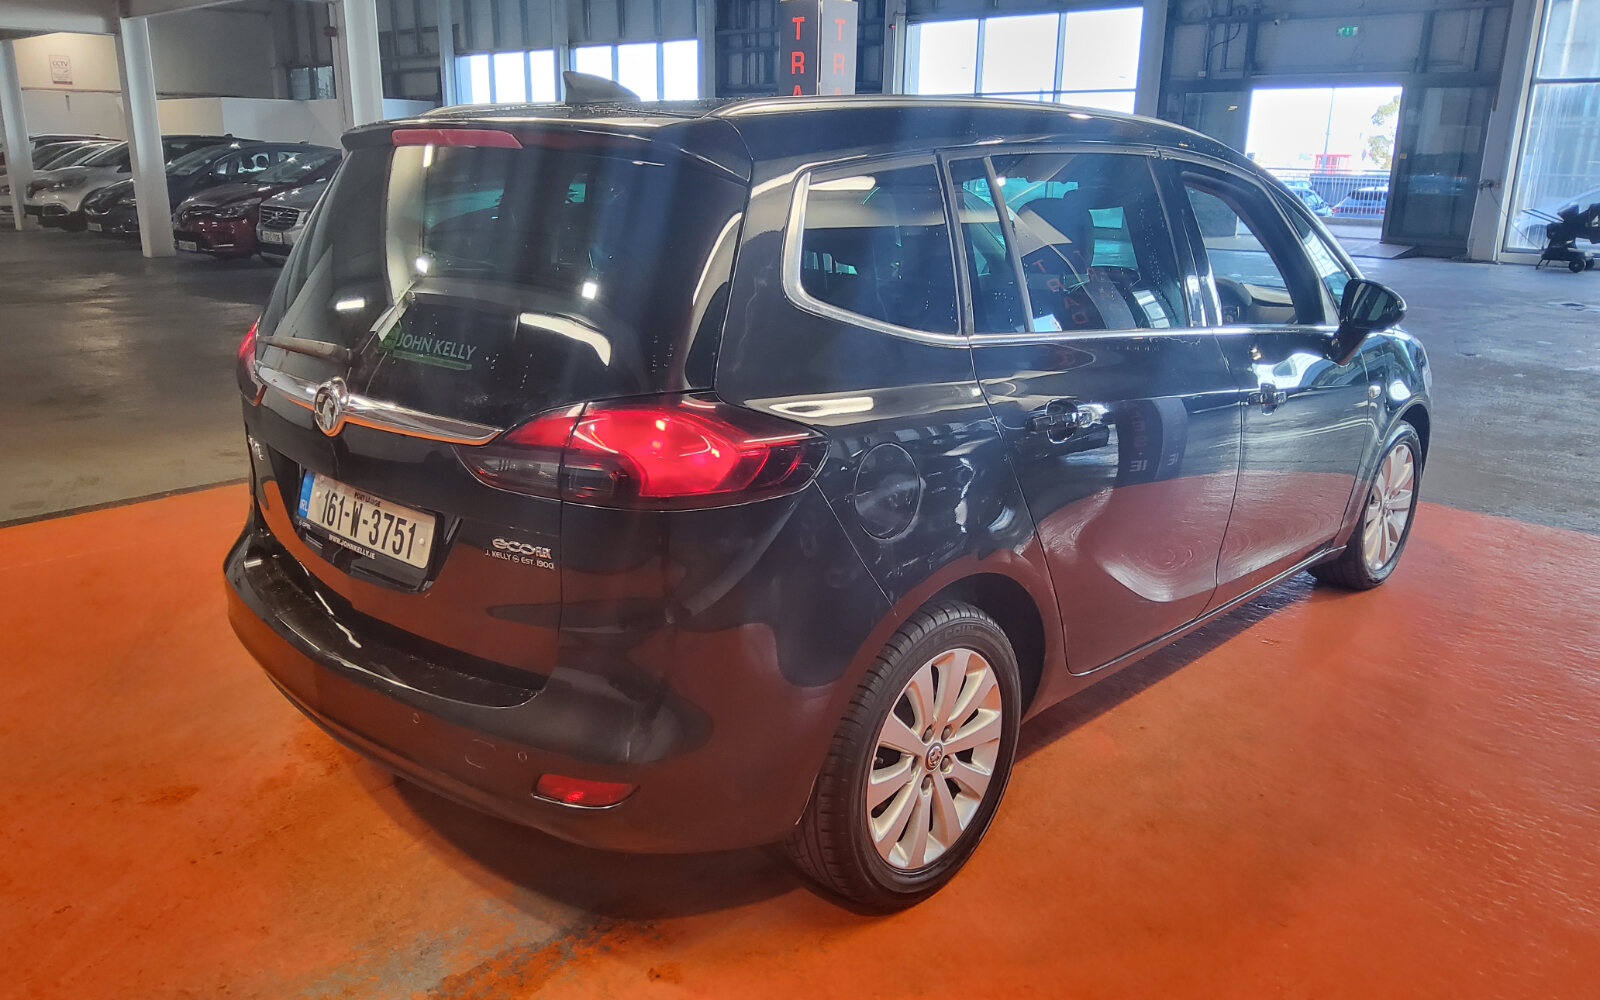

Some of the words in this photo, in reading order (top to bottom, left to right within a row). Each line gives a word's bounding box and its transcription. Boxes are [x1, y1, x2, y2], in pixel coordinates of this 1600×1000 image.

[396, 332, 433, 353] JOHN
[433, 340, 477, 361] KELLY
[321, 489, 417, 560] 161-W-3751
[484, 549, 491, 557] J.
[492, 550, 512, 561] KELLY
[536, 559, 555, 570] 1900
